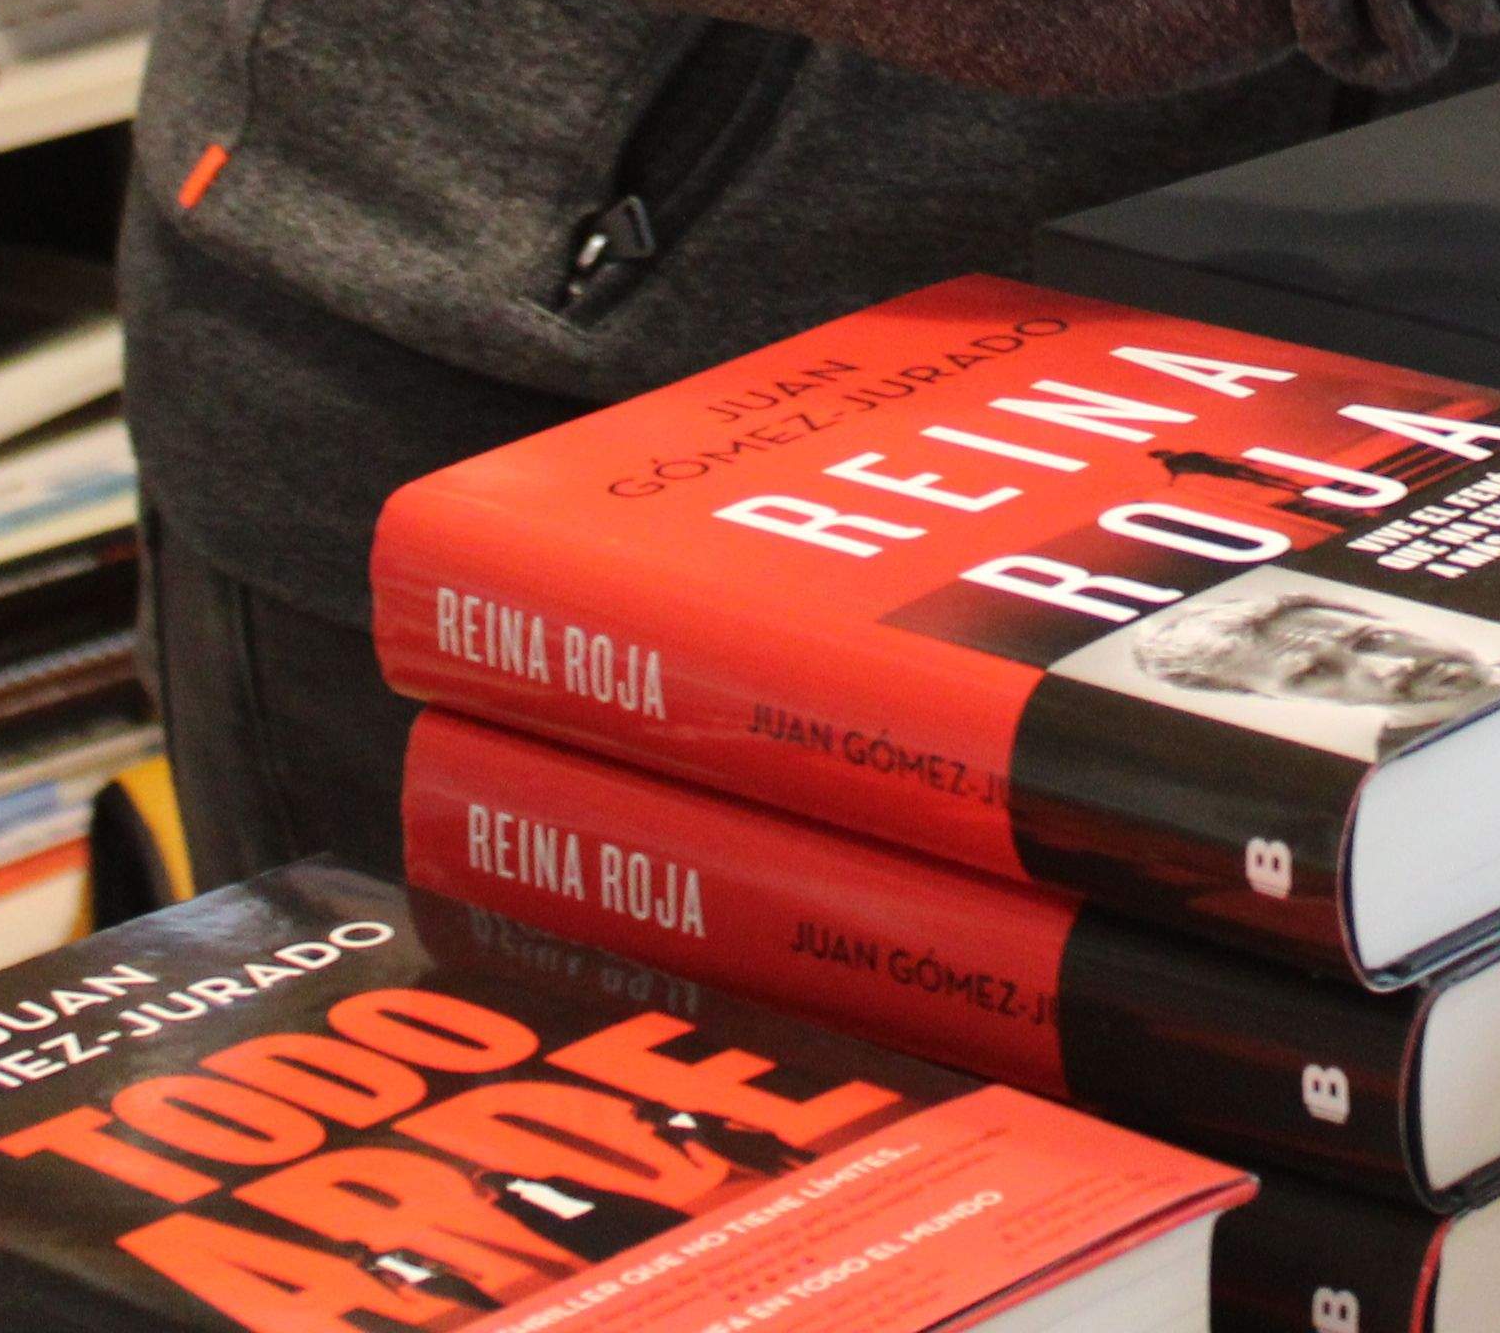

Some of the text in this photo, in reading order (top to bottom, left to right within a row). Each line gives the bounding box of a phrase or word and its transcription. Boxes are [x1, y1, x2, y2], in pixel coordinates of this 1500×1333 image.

[607, 316, 1069, 501] GÓMEZ-JURADO
[706, 357, 860, 424] JUAN
[713, 345, 1297, 558] REINA
[1346, 519, 1429, 553] VIVE
[1409, 505, 1465, 525] EL
[1377, 540, 1451, 570] QUE
[1428, 522, 1491, 545] HA
[1425, 562, 1468, 579] A
[436, 586, 550, 685] REINA
[564, 625, 667, 721] ROJA
[750, 704, 833, 752] JUAN
[468, 803, 586, 901] REINA
[600, 843, 707, 938] ROJA
[792, 922, 878, 971] JUAN
[114, 1011, 903, 1333] ARDE
[620, 1253, 685, 1286] QUE
[680, 1231, 730, 1258] NO
[725, 1195, 803, 1235] TIENE
[746, 1189, 1005, 1323] EN TODO EL MUNDO
